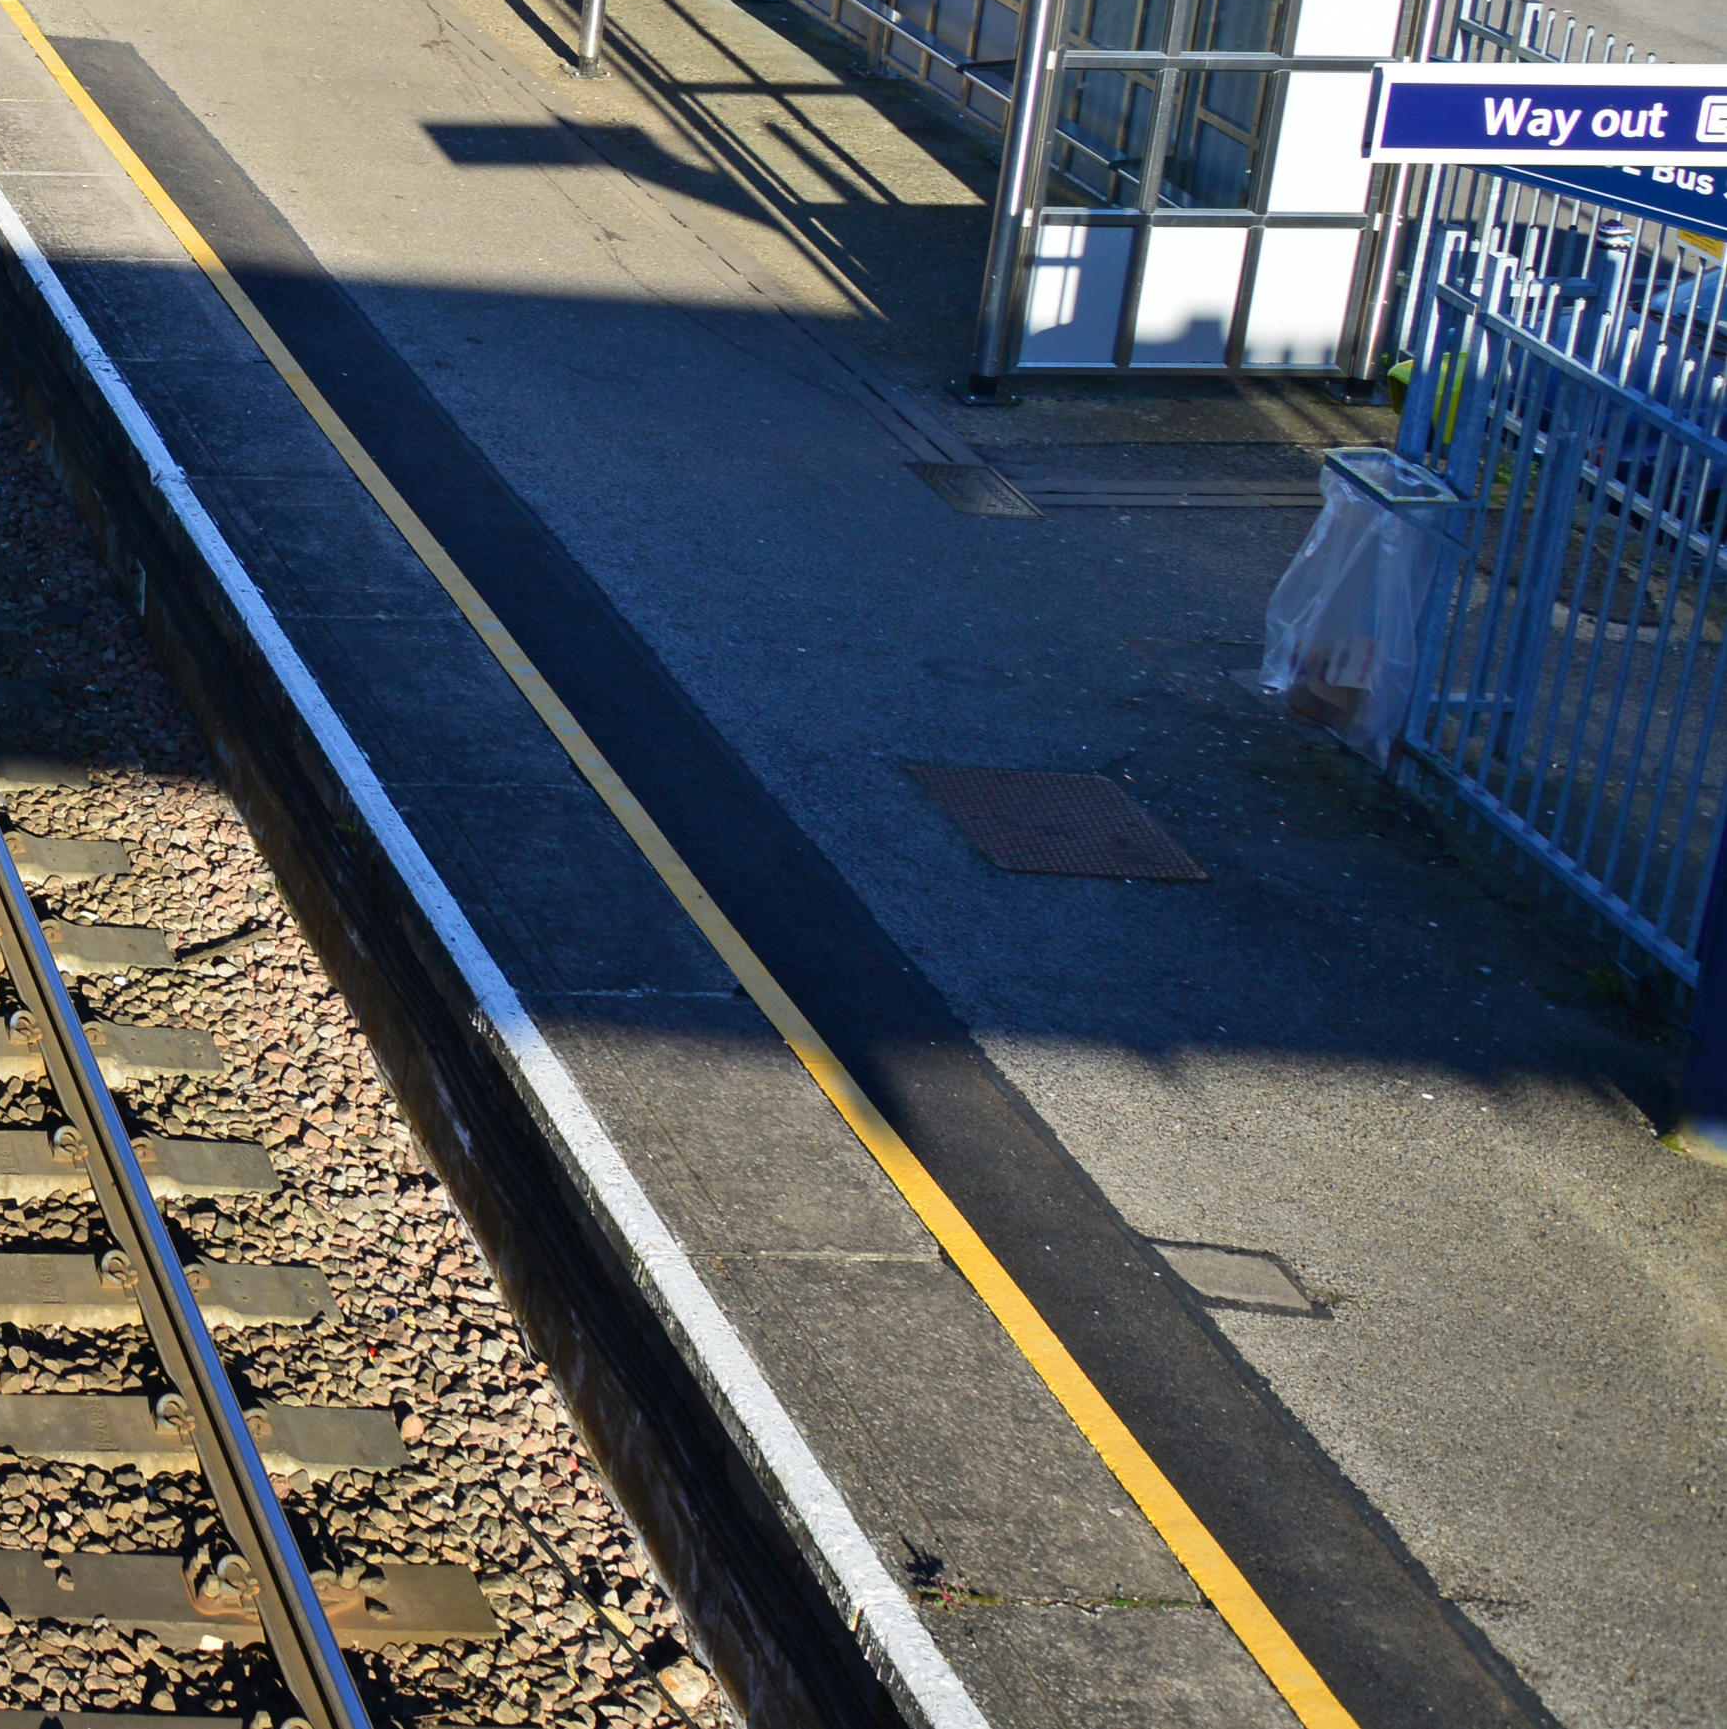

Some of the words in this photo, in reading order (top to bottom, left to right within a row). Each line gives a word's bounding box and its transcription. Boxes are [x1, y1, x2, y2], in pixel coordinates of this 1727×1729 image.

[1484, 97, 1583, 147] Way
[1591, 102, 1668, 139] out
[1652, 166, 1715, 195] Bus
